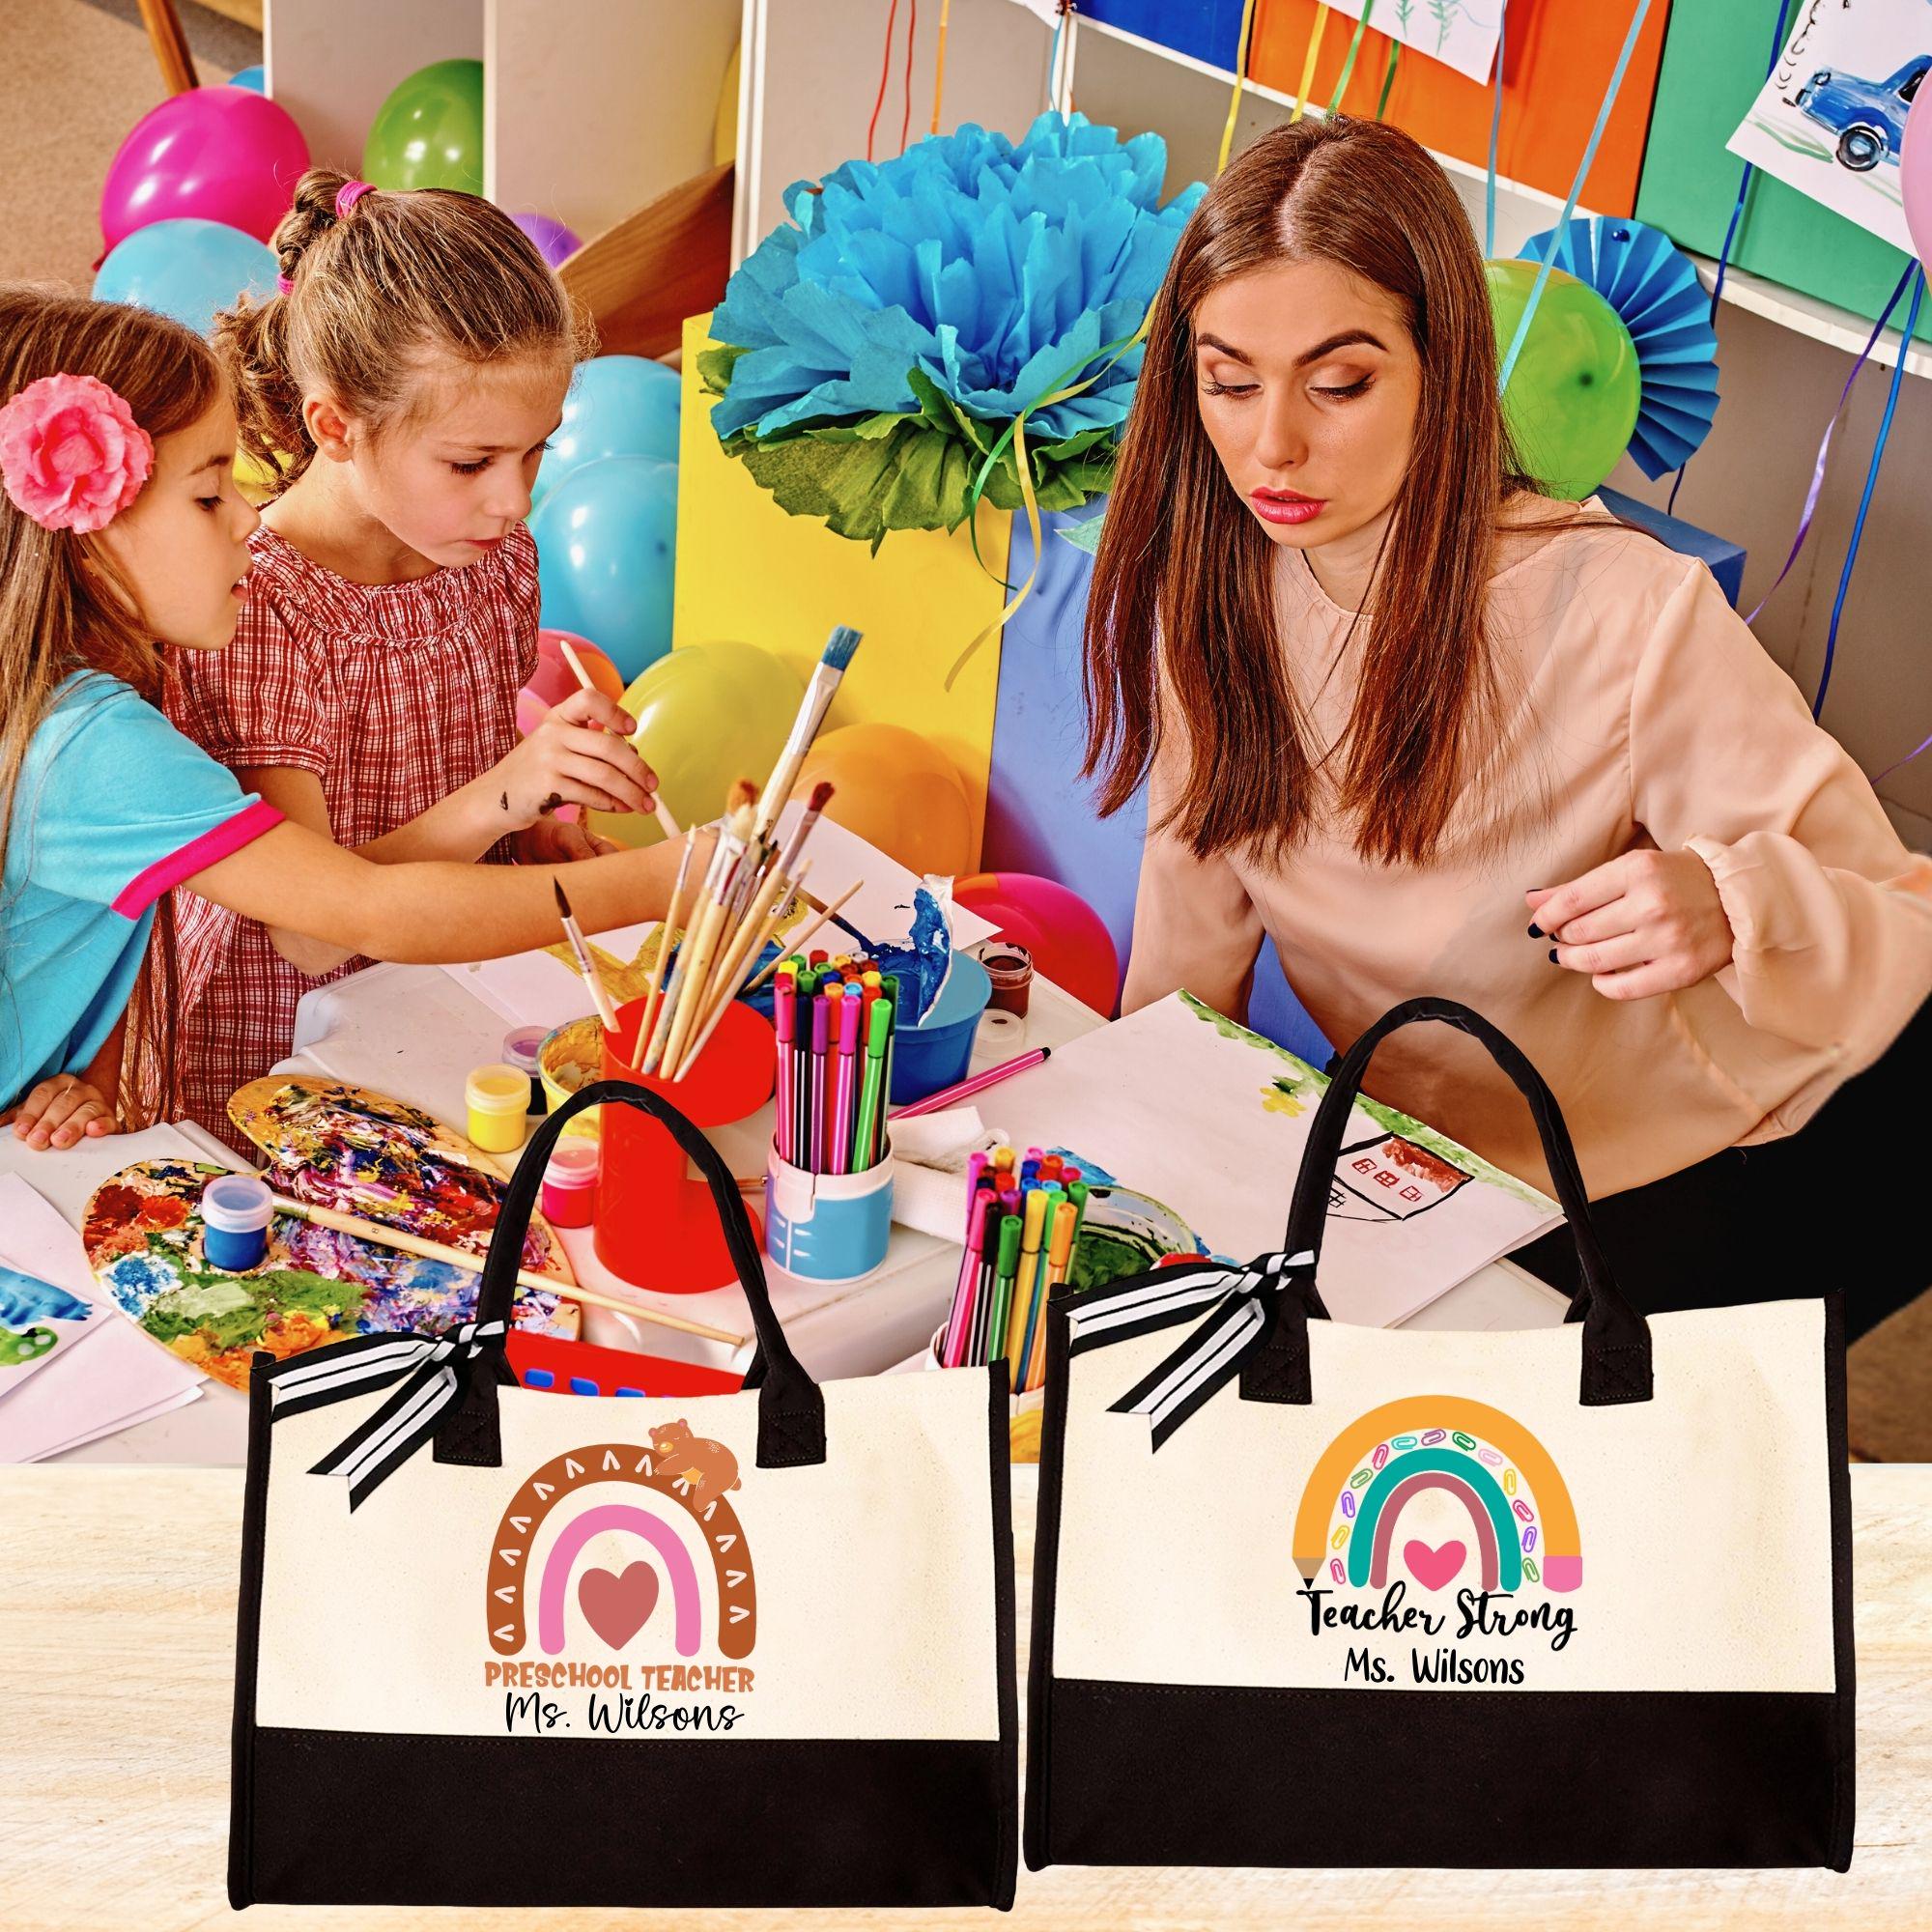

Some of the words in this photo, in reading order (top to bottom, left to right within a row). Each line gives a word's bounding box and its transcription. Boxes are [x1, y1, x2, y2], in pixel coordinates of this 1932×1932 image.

[1296, 1580, 1446, 1636] Teacher
[1457, 1588, 1578, 1652] Strong
[484, 1661, 632, 1690] PRESCHOOL
[640, 1664, 755, 1693] TEACHER
[1344, 1647, 1395, 1684] Ms.
[1411, 1647, 1525, 1685] Wilsons
[505, 1691, 571, 1734] Ms.
[588, 1692, 745, 1734] Wilsons
